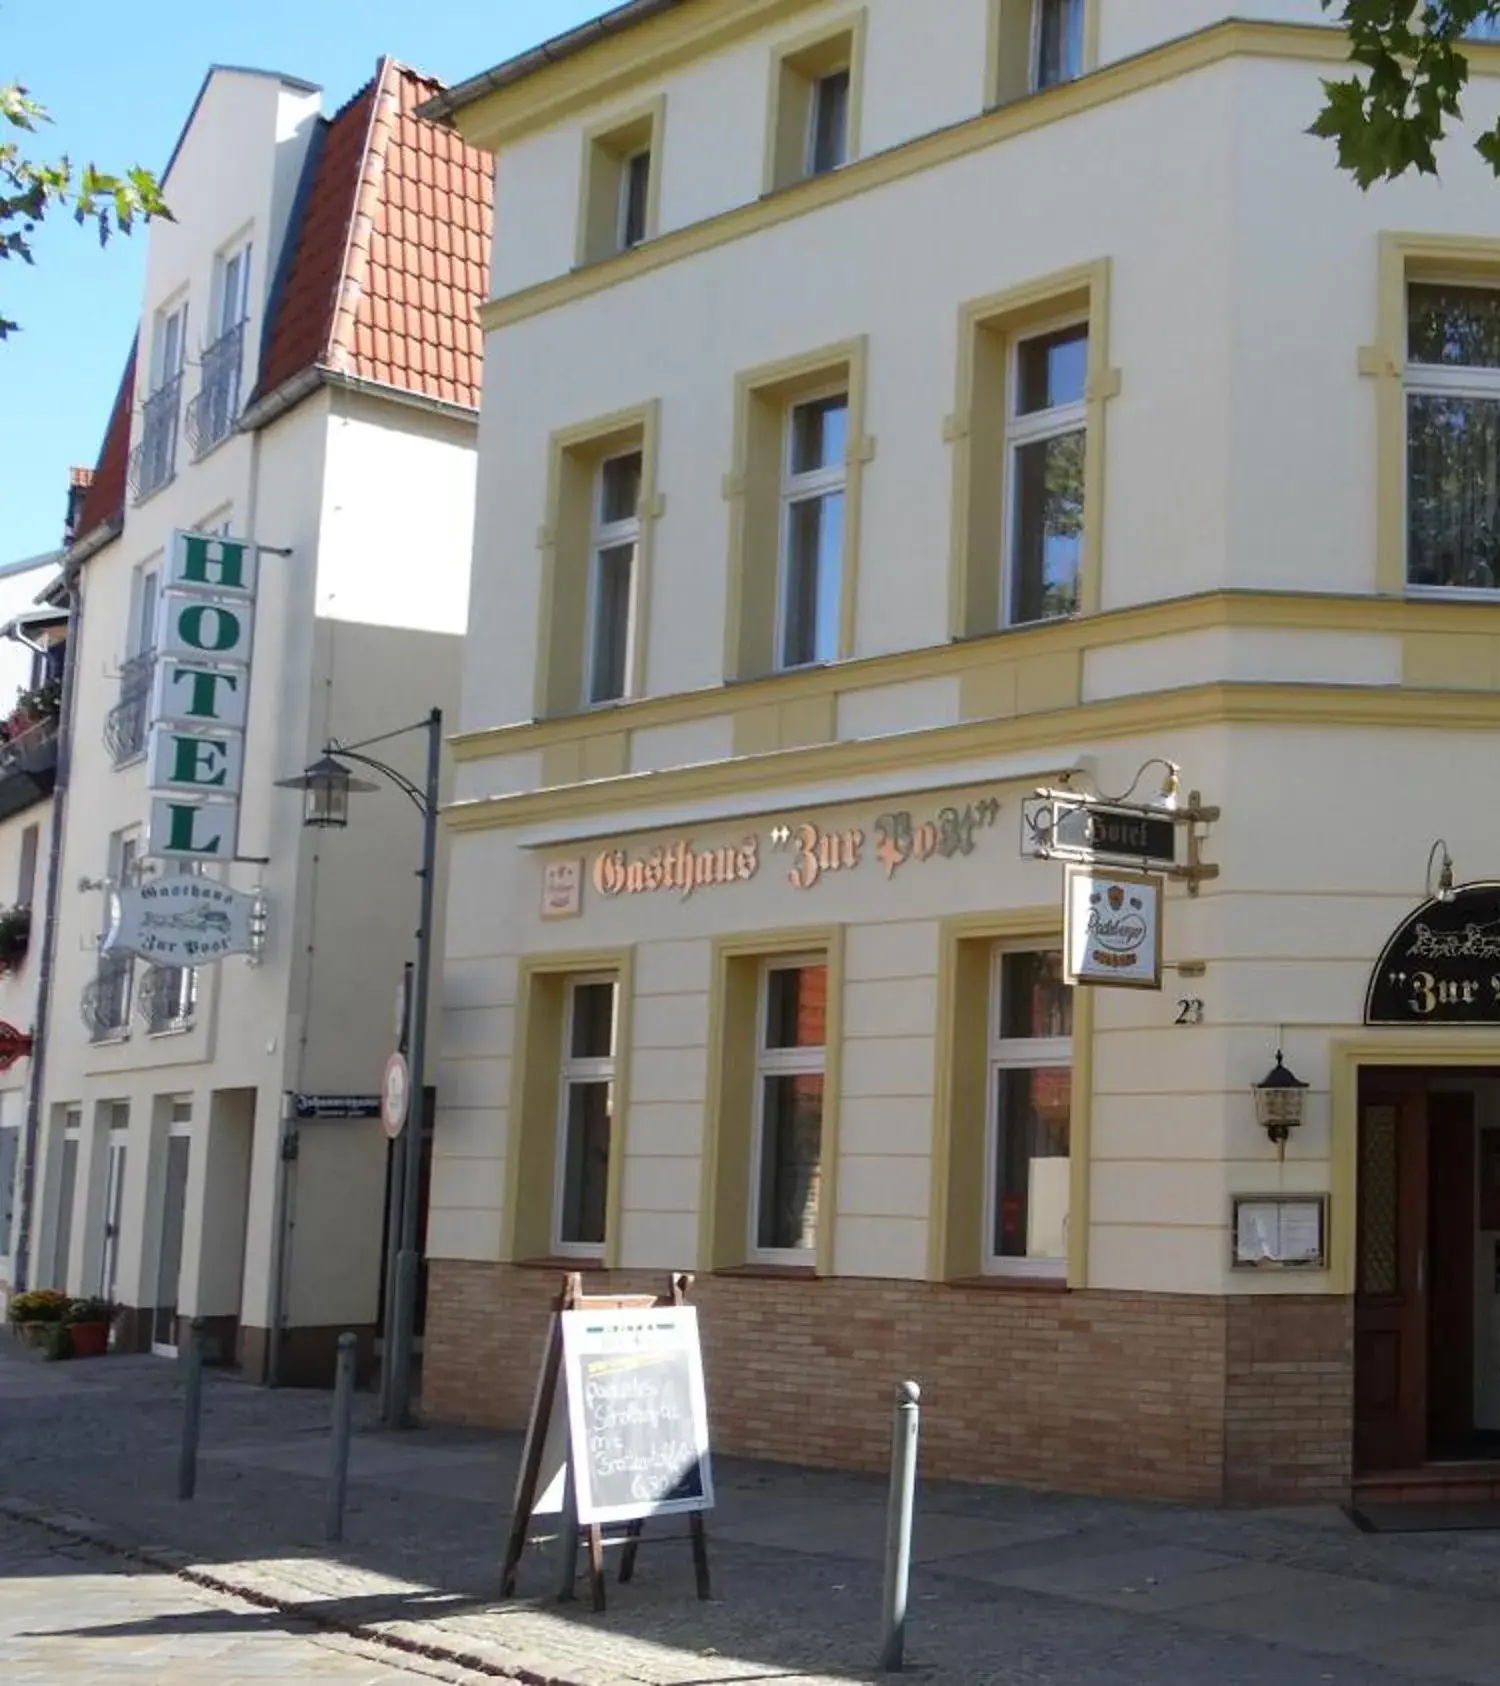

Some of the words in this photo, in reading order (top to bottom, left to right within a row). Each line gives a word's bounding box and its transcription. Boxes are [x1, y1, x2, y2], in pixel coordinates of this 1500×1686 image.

[164, 535, 249, 853] HOTEL
[141, 884, 232, 904] Gasthaus
[593, 834, 760, 903] Gasthaus
